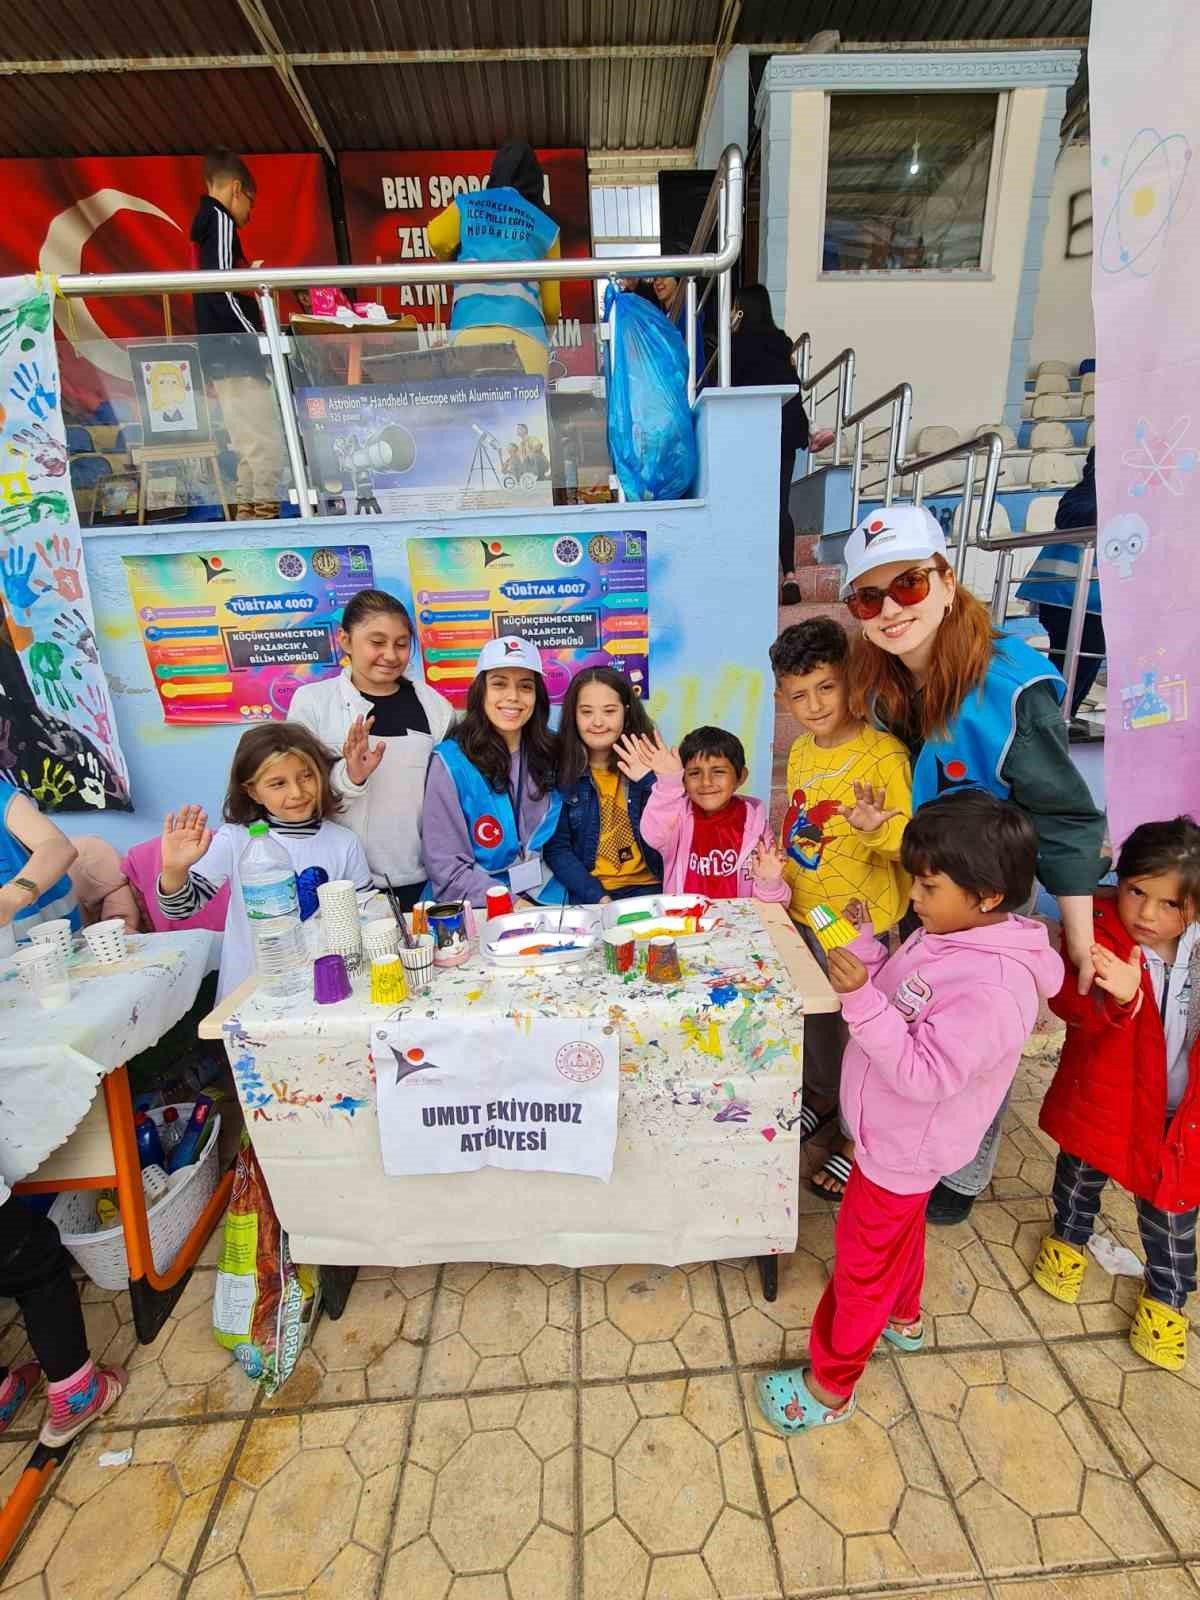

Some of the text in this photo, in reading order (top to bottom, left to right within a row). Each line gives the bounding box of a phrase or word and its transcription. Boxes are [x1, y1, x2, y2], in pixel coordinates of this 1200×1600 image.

[382, 177, 423, 209] BEN
[370, 391, 408, 409] Handheld
[410, 391, 449, 407] Telescope
[449, 389, 467, 403] with
[469, 387, 512, 402] Aluminium
[513, 384, 540, 405] Tripod
[505, 583, 586, 596] TÜBİTAK 4007
[231, 598, 314, 612] TÜBİTAK 4007
[249, 652, 275, 664] BİLİM
[422, 1098, 583, 1127] UMUT EKİYORUZ
[460, 1125, 547, 1152] ATÖLYESİ
